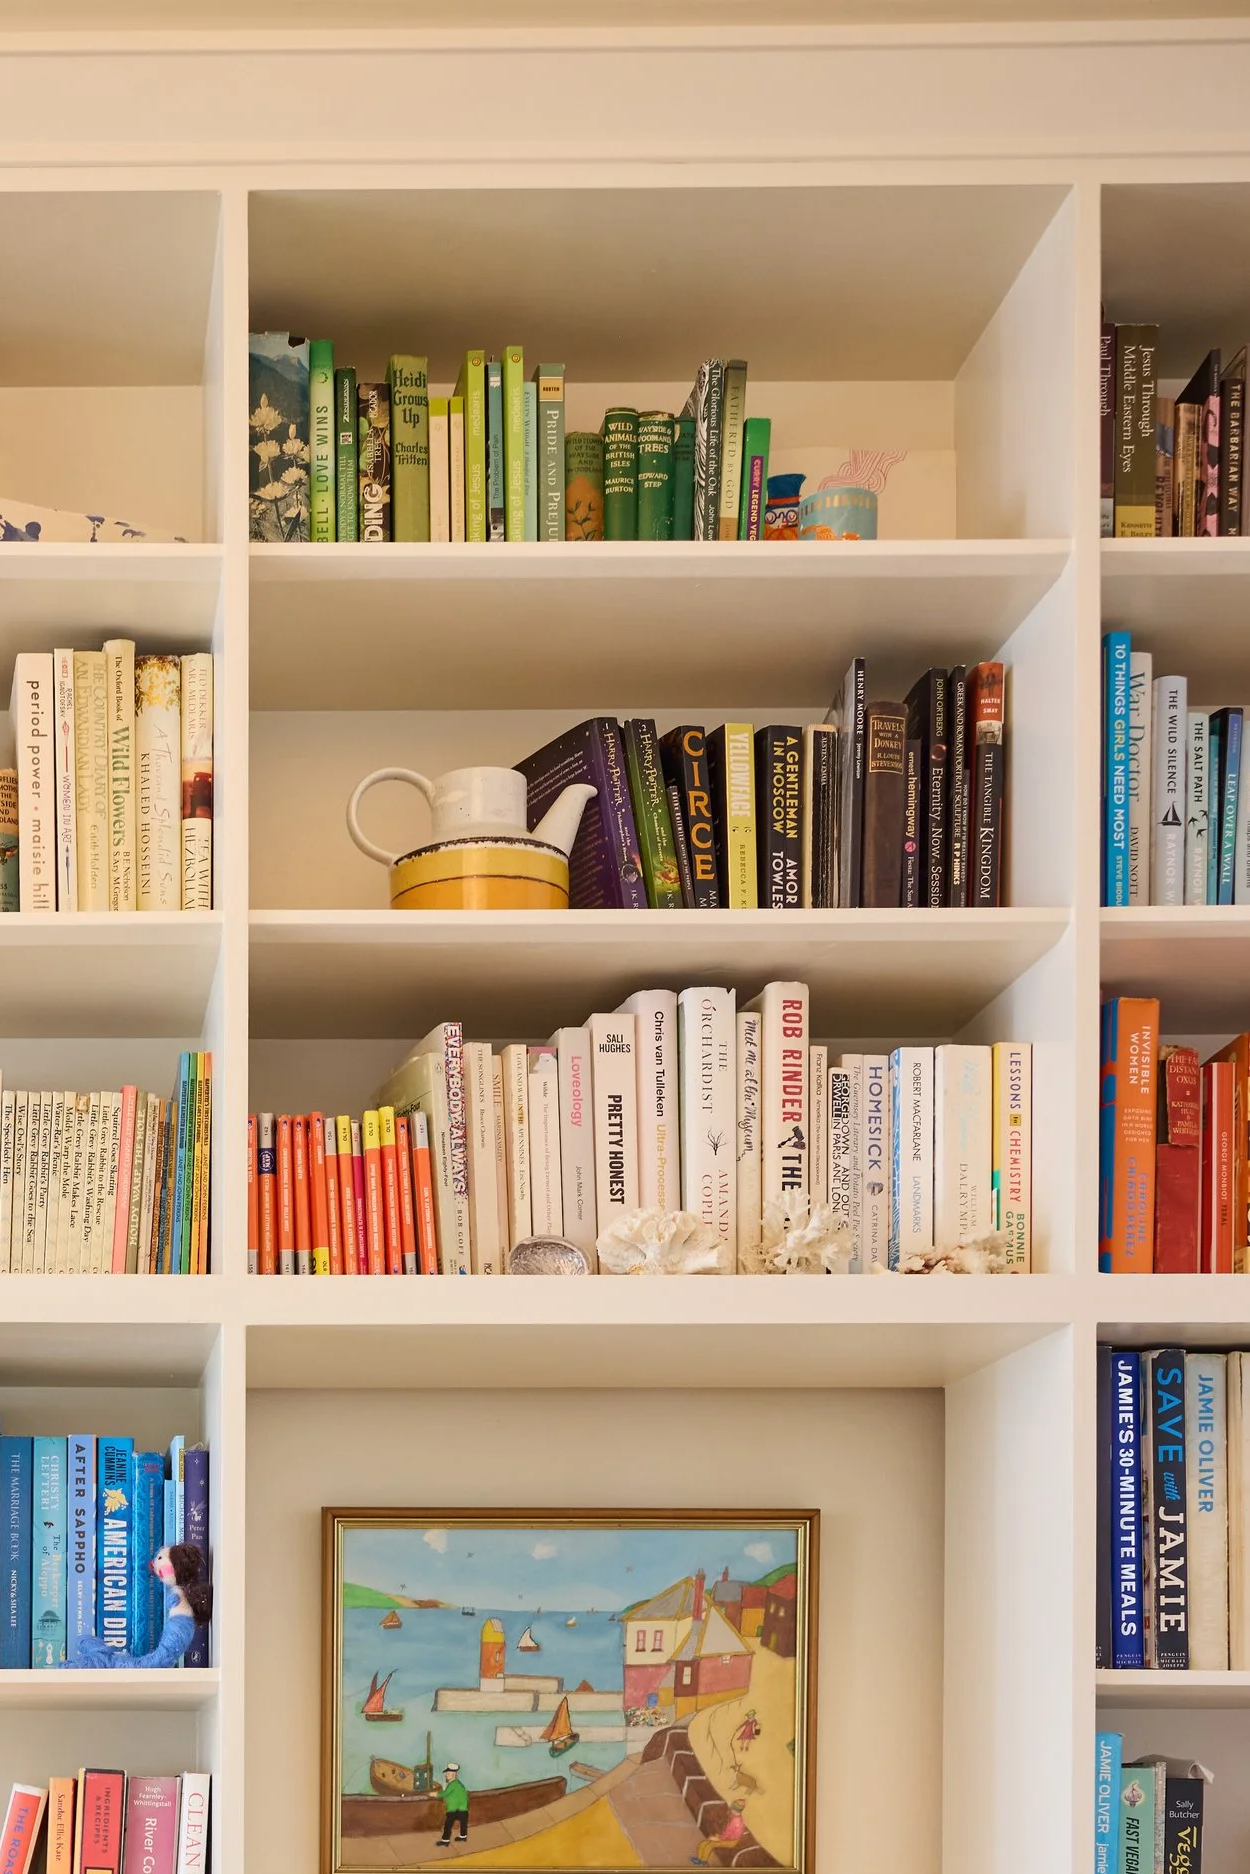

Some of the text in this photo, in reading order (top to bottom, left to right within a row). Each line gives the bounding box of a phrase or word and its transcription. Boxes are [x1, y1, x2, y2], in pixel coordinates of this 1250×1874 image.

[393, 391, 427, 406] Grows
[395, 370, 425, 388] Heidi
[1120, 346, 1136, 472] Middle Eastern Eyes
[1139, 346, 1154, 437] Jesus Through
[395, 442, 428, 454] Charles
[403, 409, 419, 428] Up
[606, 434, 636, 443] ANIMALS
[609, 423, 633, 432] WILD
[395, 455, 427, 465] Tritten
[730, 733, 750, 817] YELLOWFACE
[1167, 690, 1177, 794] THE WILD SILENCE
[27, 680, 49, 909] period power maisie hill
[141, 753, 150, 895] KHALED HOSSEINI
[683, 731, 714, 880] CIRCE
[773, 742, 784, 834] IN MOSCOW
[786, 736, 798, 839] A GENTLEMAN
[599, 1044, 630, 1053] HUGHES
[607, 1034, 623, 1043] SALI
[654, 1011, 666, 1117] Chris van Tulleken
[701, 999, 716, 1114] ORCHARDIST
[718, 1042, 727, 1072] THE
[1130, 1033, 1139, 1084] WOMEN
[1141, 1026, 1150, 1094] INVISIBLE
[571, 1056, 582, 1128] Loveology
[782, 1000, 802, 1191] ROB RINDER THE
[868, 1066, 882, 1170] HOMESICK
[1010, 1052, 1021, 1110] LESSONS
[4, 1124, 12, 1164] Speckledy
[608, 1094, 625, 1204] PRETTY HONEST
[1010, 1131, 1021, 1202] CHEMISTRY
[1198, 1375, 1213, 1513] JAMIE OLIVER
[75, 1444, 86, 1574] AFTER SAPPHO
[1117, 1360, 1136, 1636] JAMIE'S 30-MINUTE MEALS
[1156, 1368, 1185, 1632] SAVE with JAMIE
[104, 1518, 126, 1611] AMERICAN
[12, 1808, 28, 1831] THE
[145, 1818, 156, 1854] River
[184, 1792, 204, 1867] CLEAN
[1176, 1800, 1194, 1810] Sally
